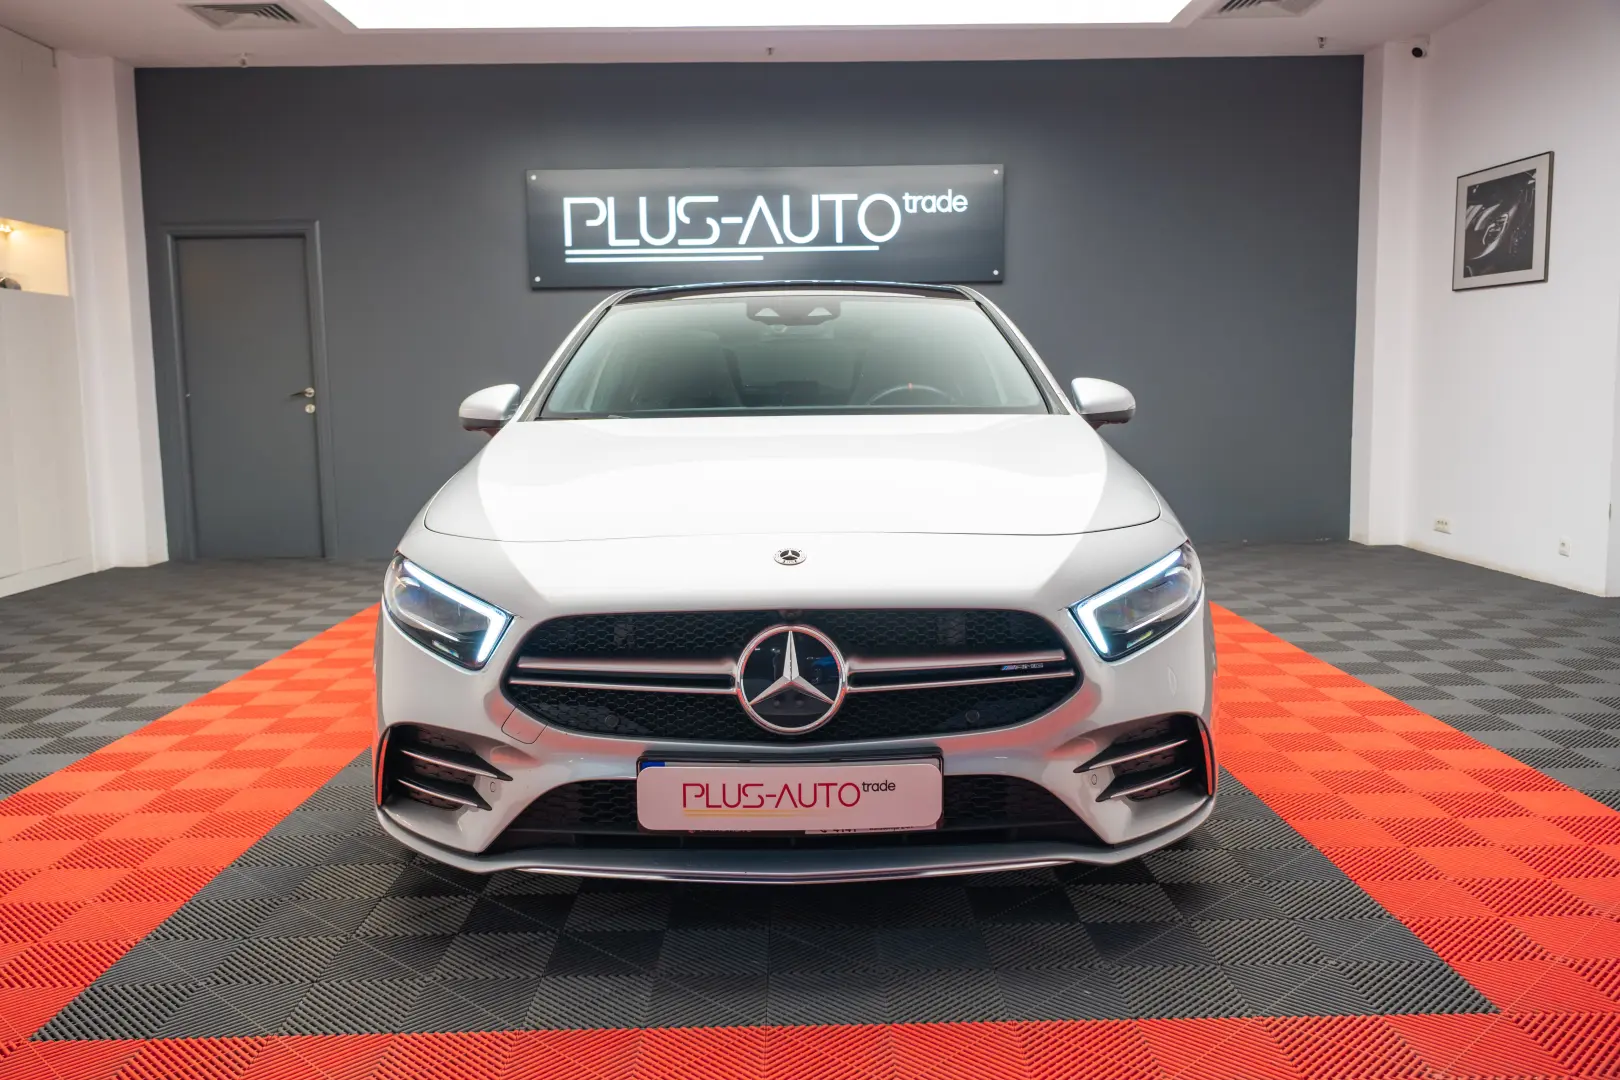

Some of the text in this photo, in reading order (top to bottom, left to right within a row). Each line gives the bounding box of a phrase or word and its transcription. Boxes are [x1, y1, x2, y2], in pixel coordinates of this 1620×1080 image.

[563, 188, 969, 247] PLUS-AUTO trade
[682, 779, 896, 809] PLUS-AUTO trade
